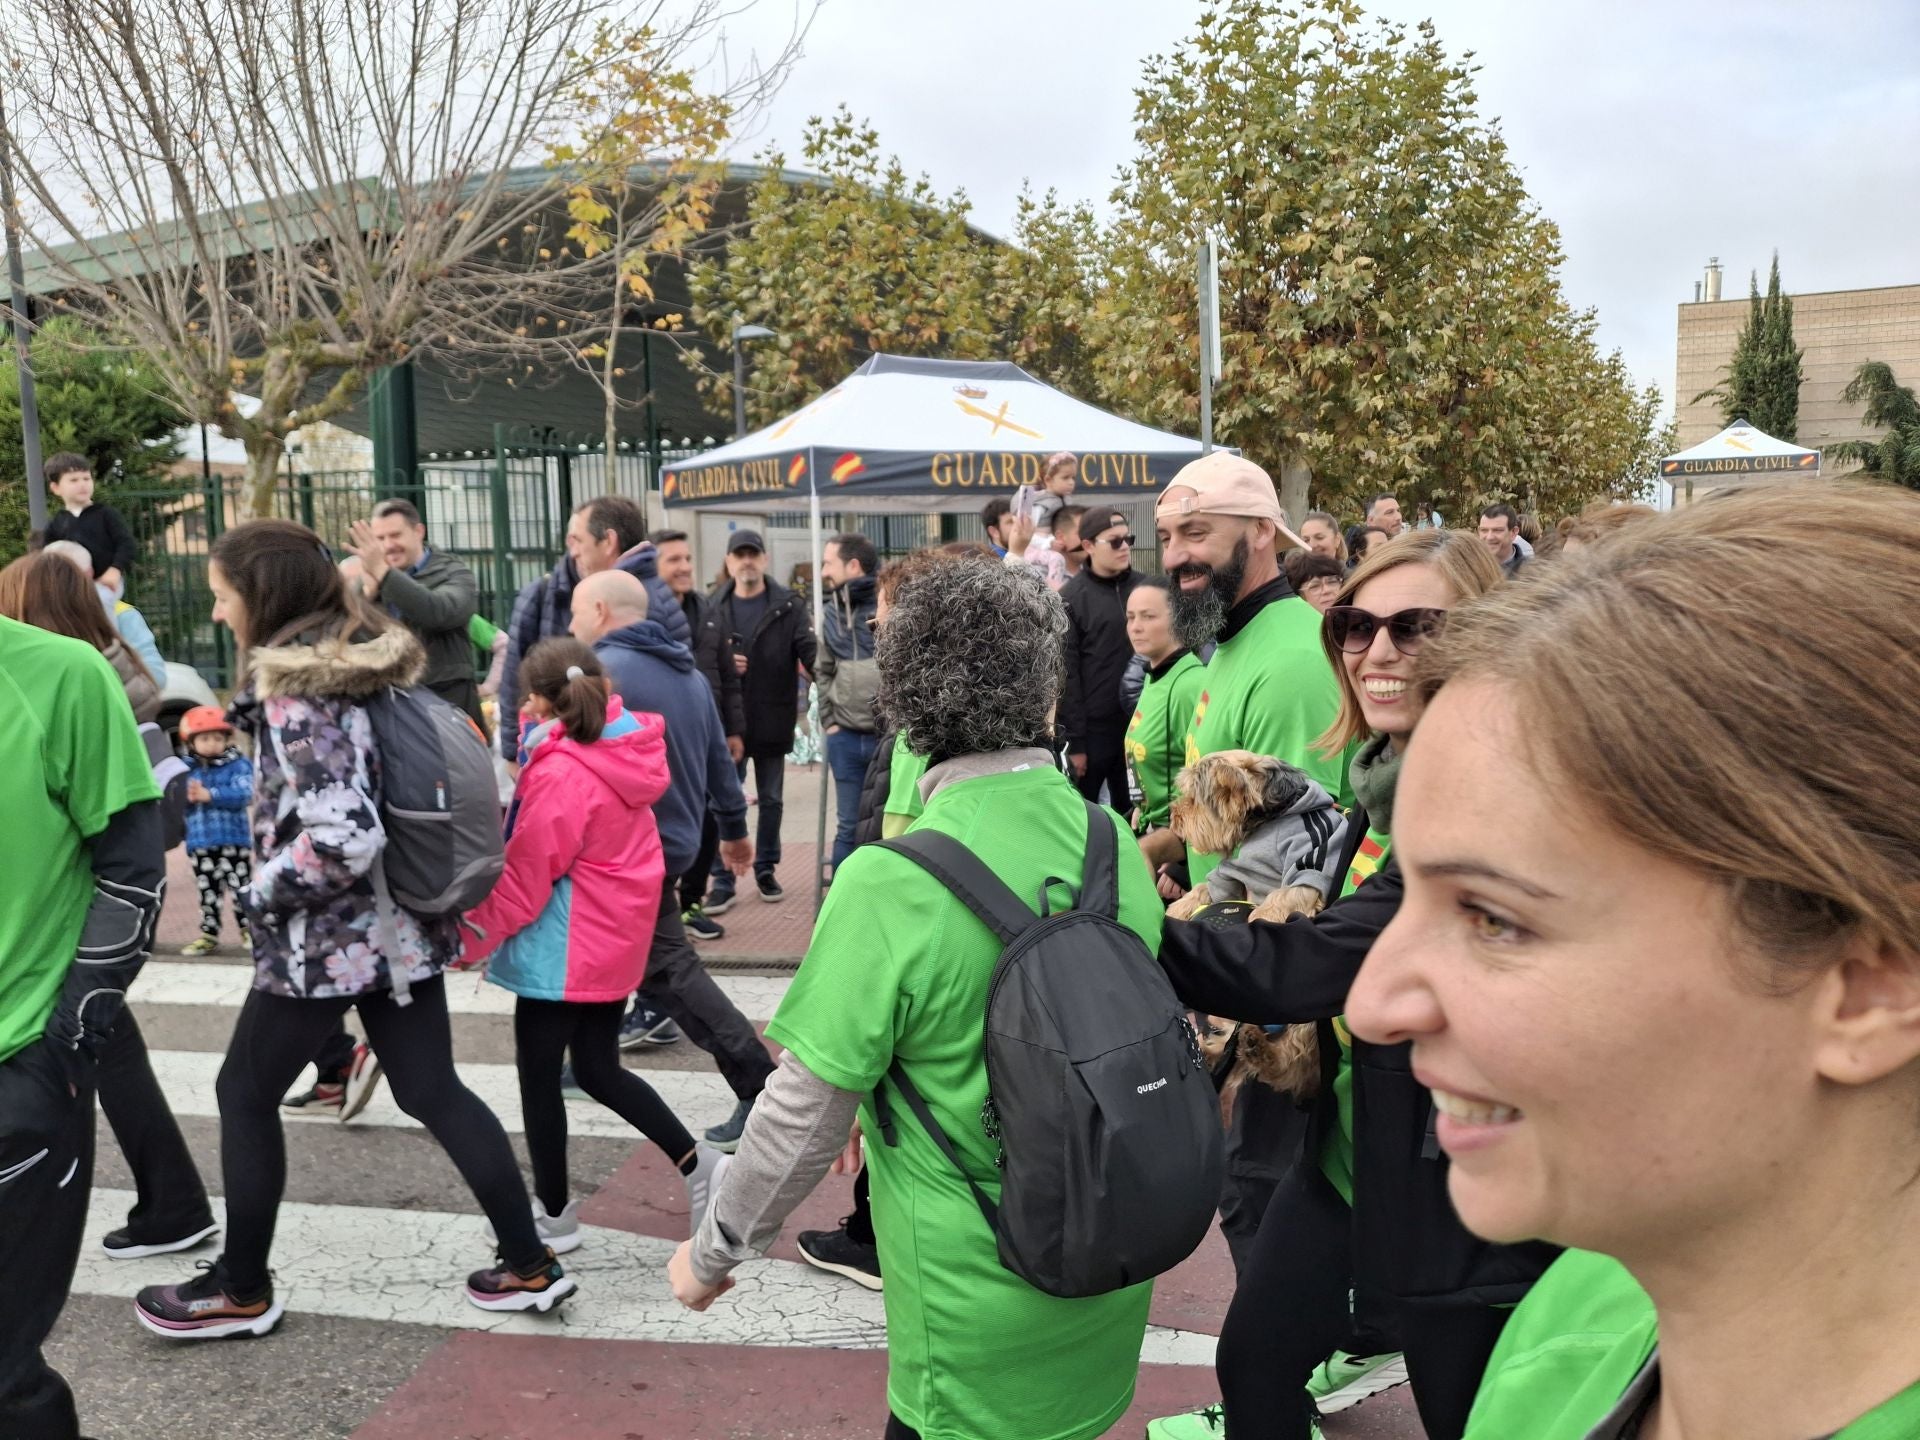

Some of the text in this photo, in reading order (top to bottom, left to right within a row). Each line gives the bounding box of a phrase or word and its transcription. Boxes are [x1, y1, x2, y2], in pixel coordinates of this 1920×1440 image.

[680, 459, 784, 499] GUARDIA CIVIL
[931, 453, 1156, 487] GUARD CIVIL
[1684, 456, 1794, 473] GUARDIA CIVIL
